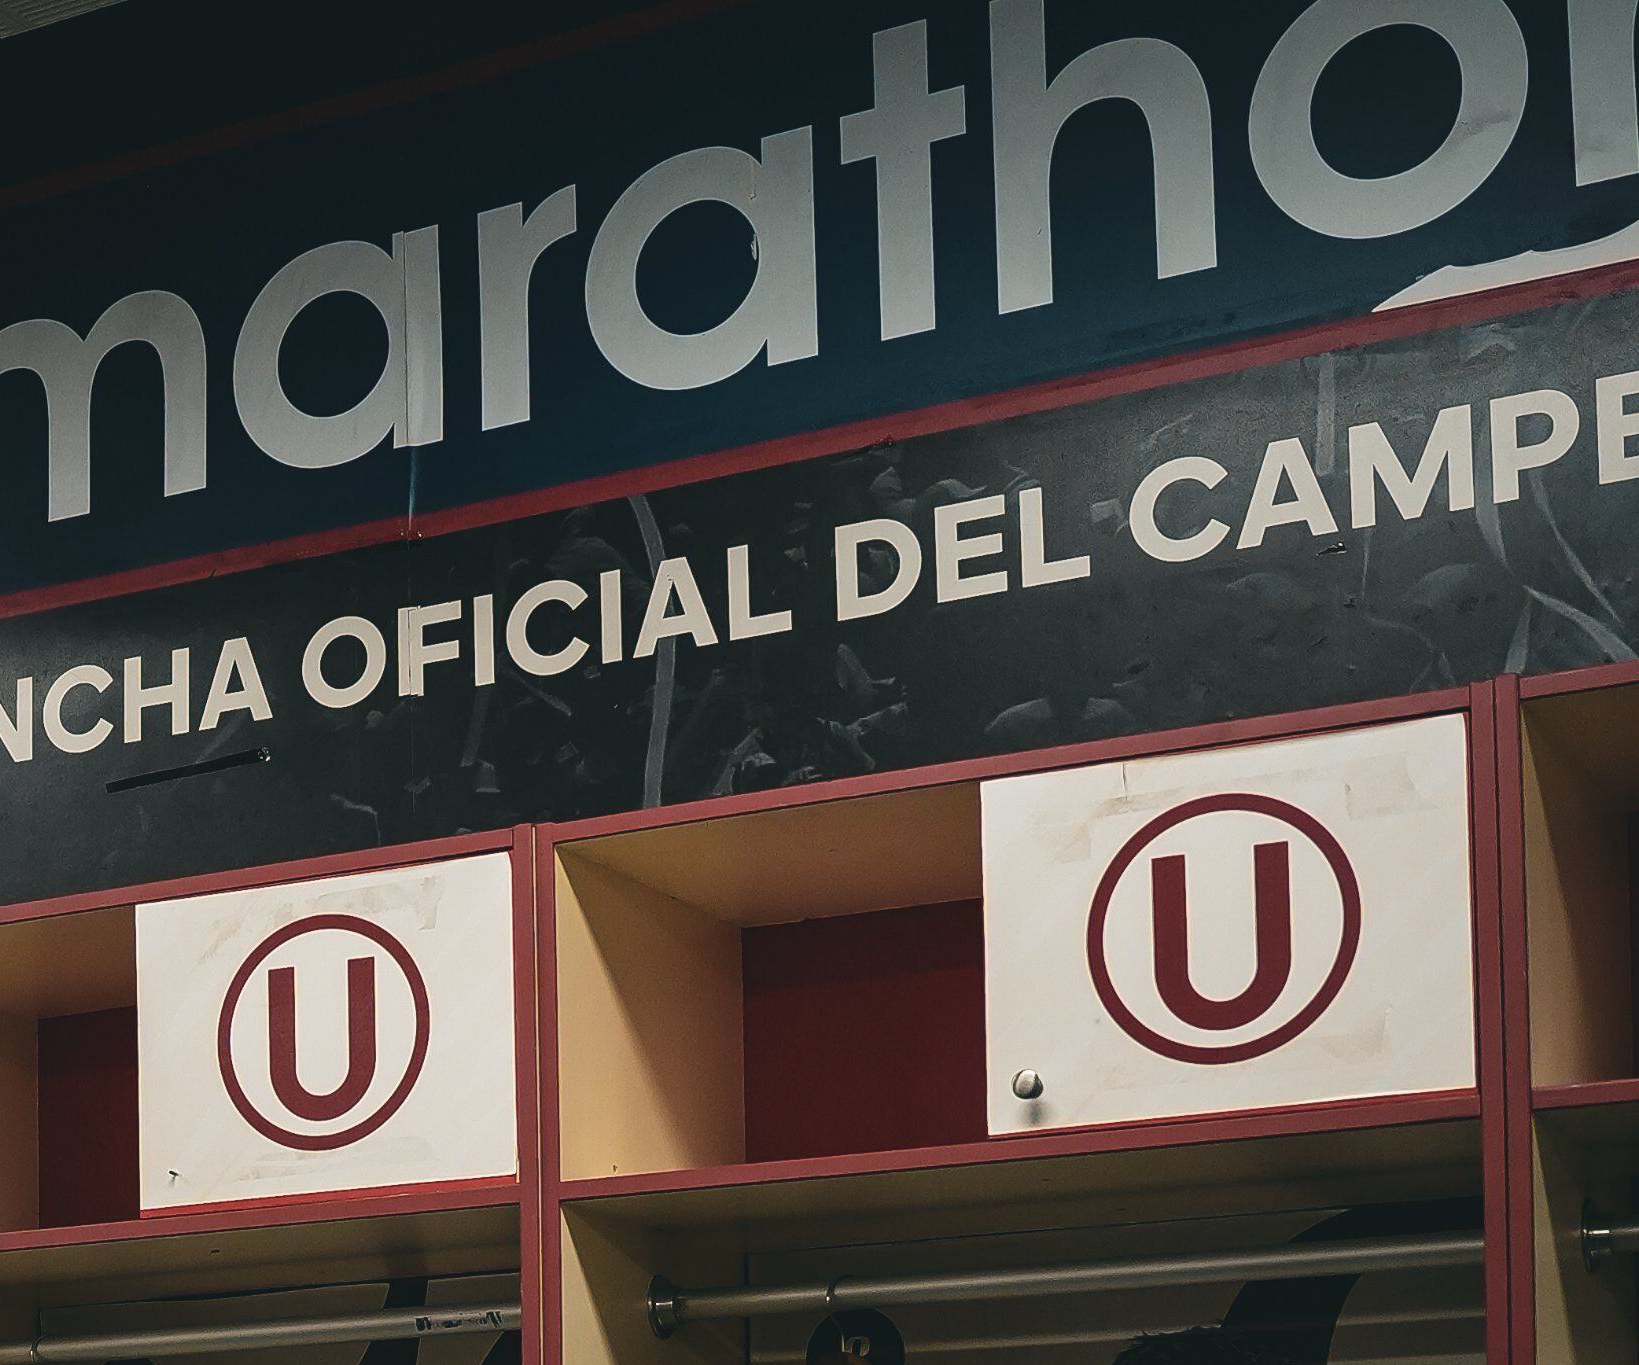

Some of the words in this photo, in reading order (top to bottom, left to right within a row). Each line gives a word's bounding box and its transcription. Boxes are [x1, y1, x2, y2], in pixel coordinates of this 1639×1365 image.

[301, 543, 792, 710] OFICIAL
[835, 487, 1091, 622] DEL
[1151, 841, 1292, 1030] U
[268, 956, 376, 1122] U
